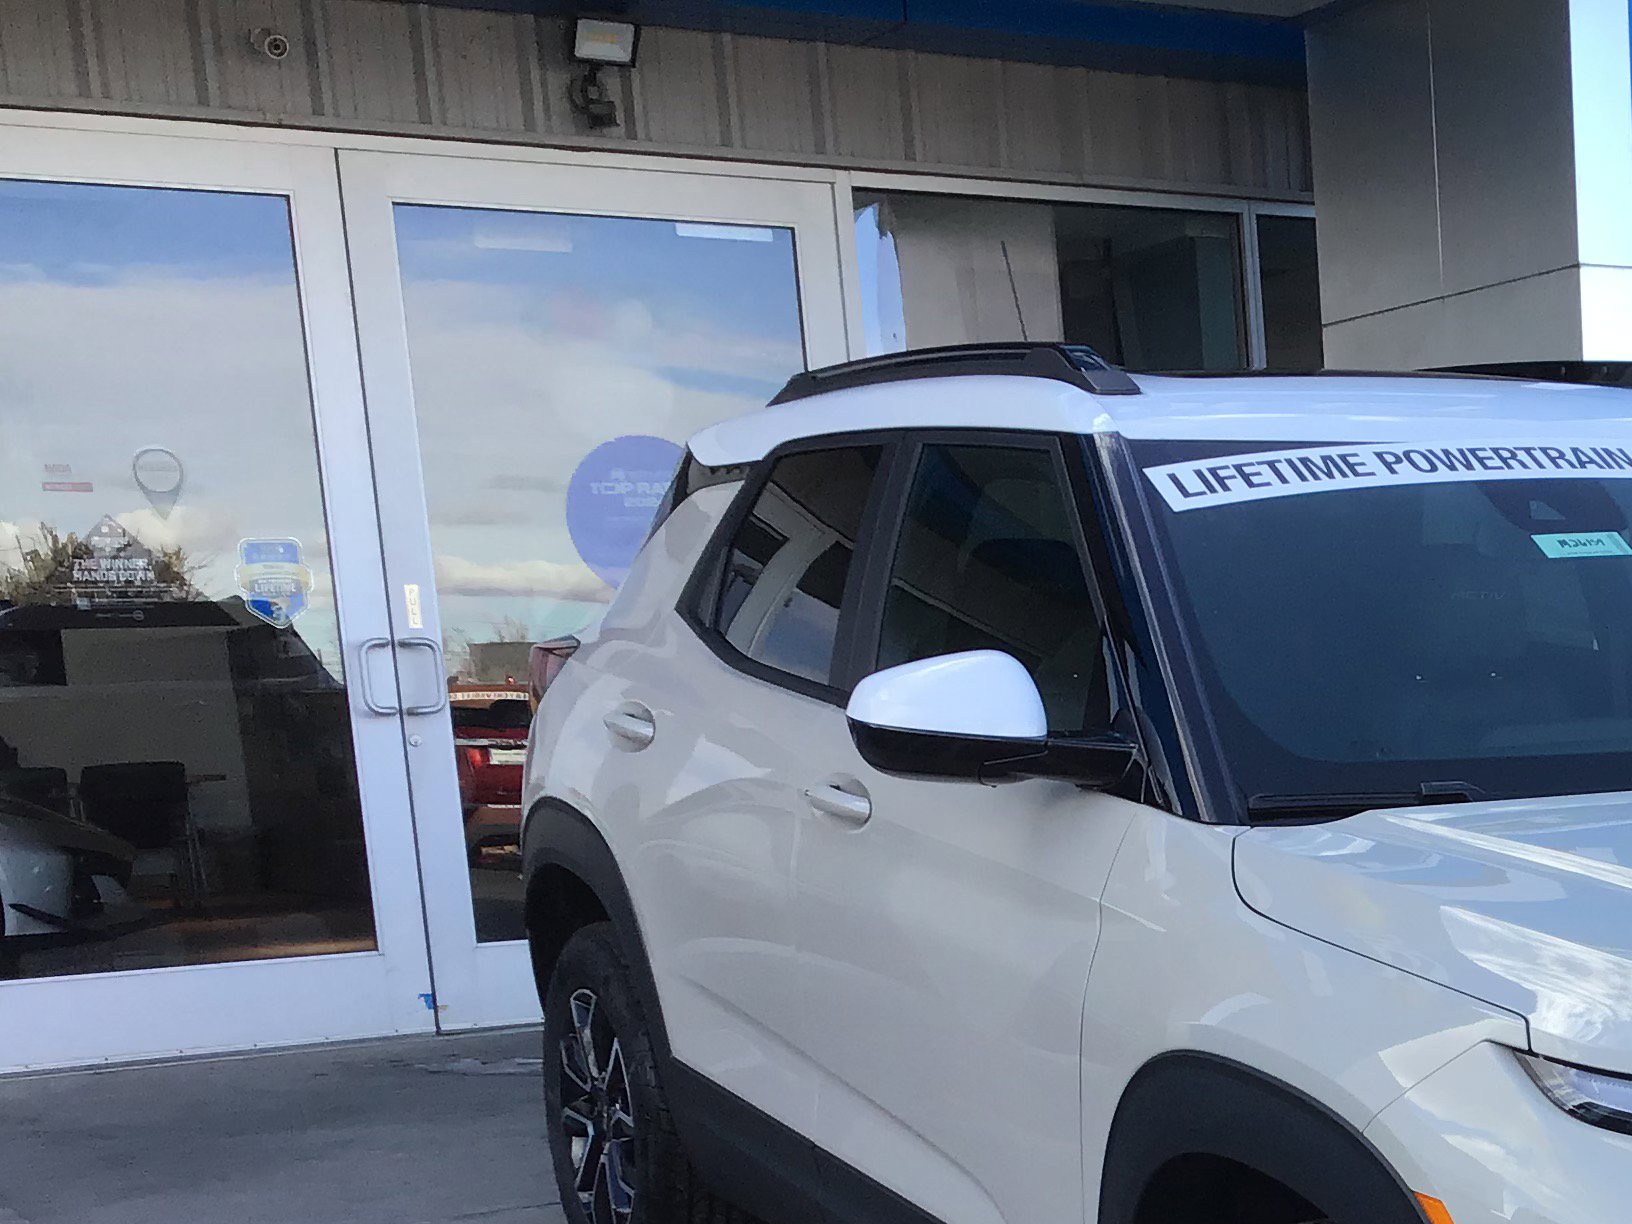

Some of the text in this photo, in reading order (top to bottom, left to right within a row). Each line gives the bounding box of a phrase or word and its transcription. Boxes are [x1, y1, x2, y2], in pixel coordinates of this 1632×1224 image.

[1167, 453, 1376, 498] LIFETIME
[73, 559, 97, 569] THE
[73, 571, 116, 581] HANDS
[255, 582, 296, 592] LIFETIME
[407, 588, 419, 625] PULL
